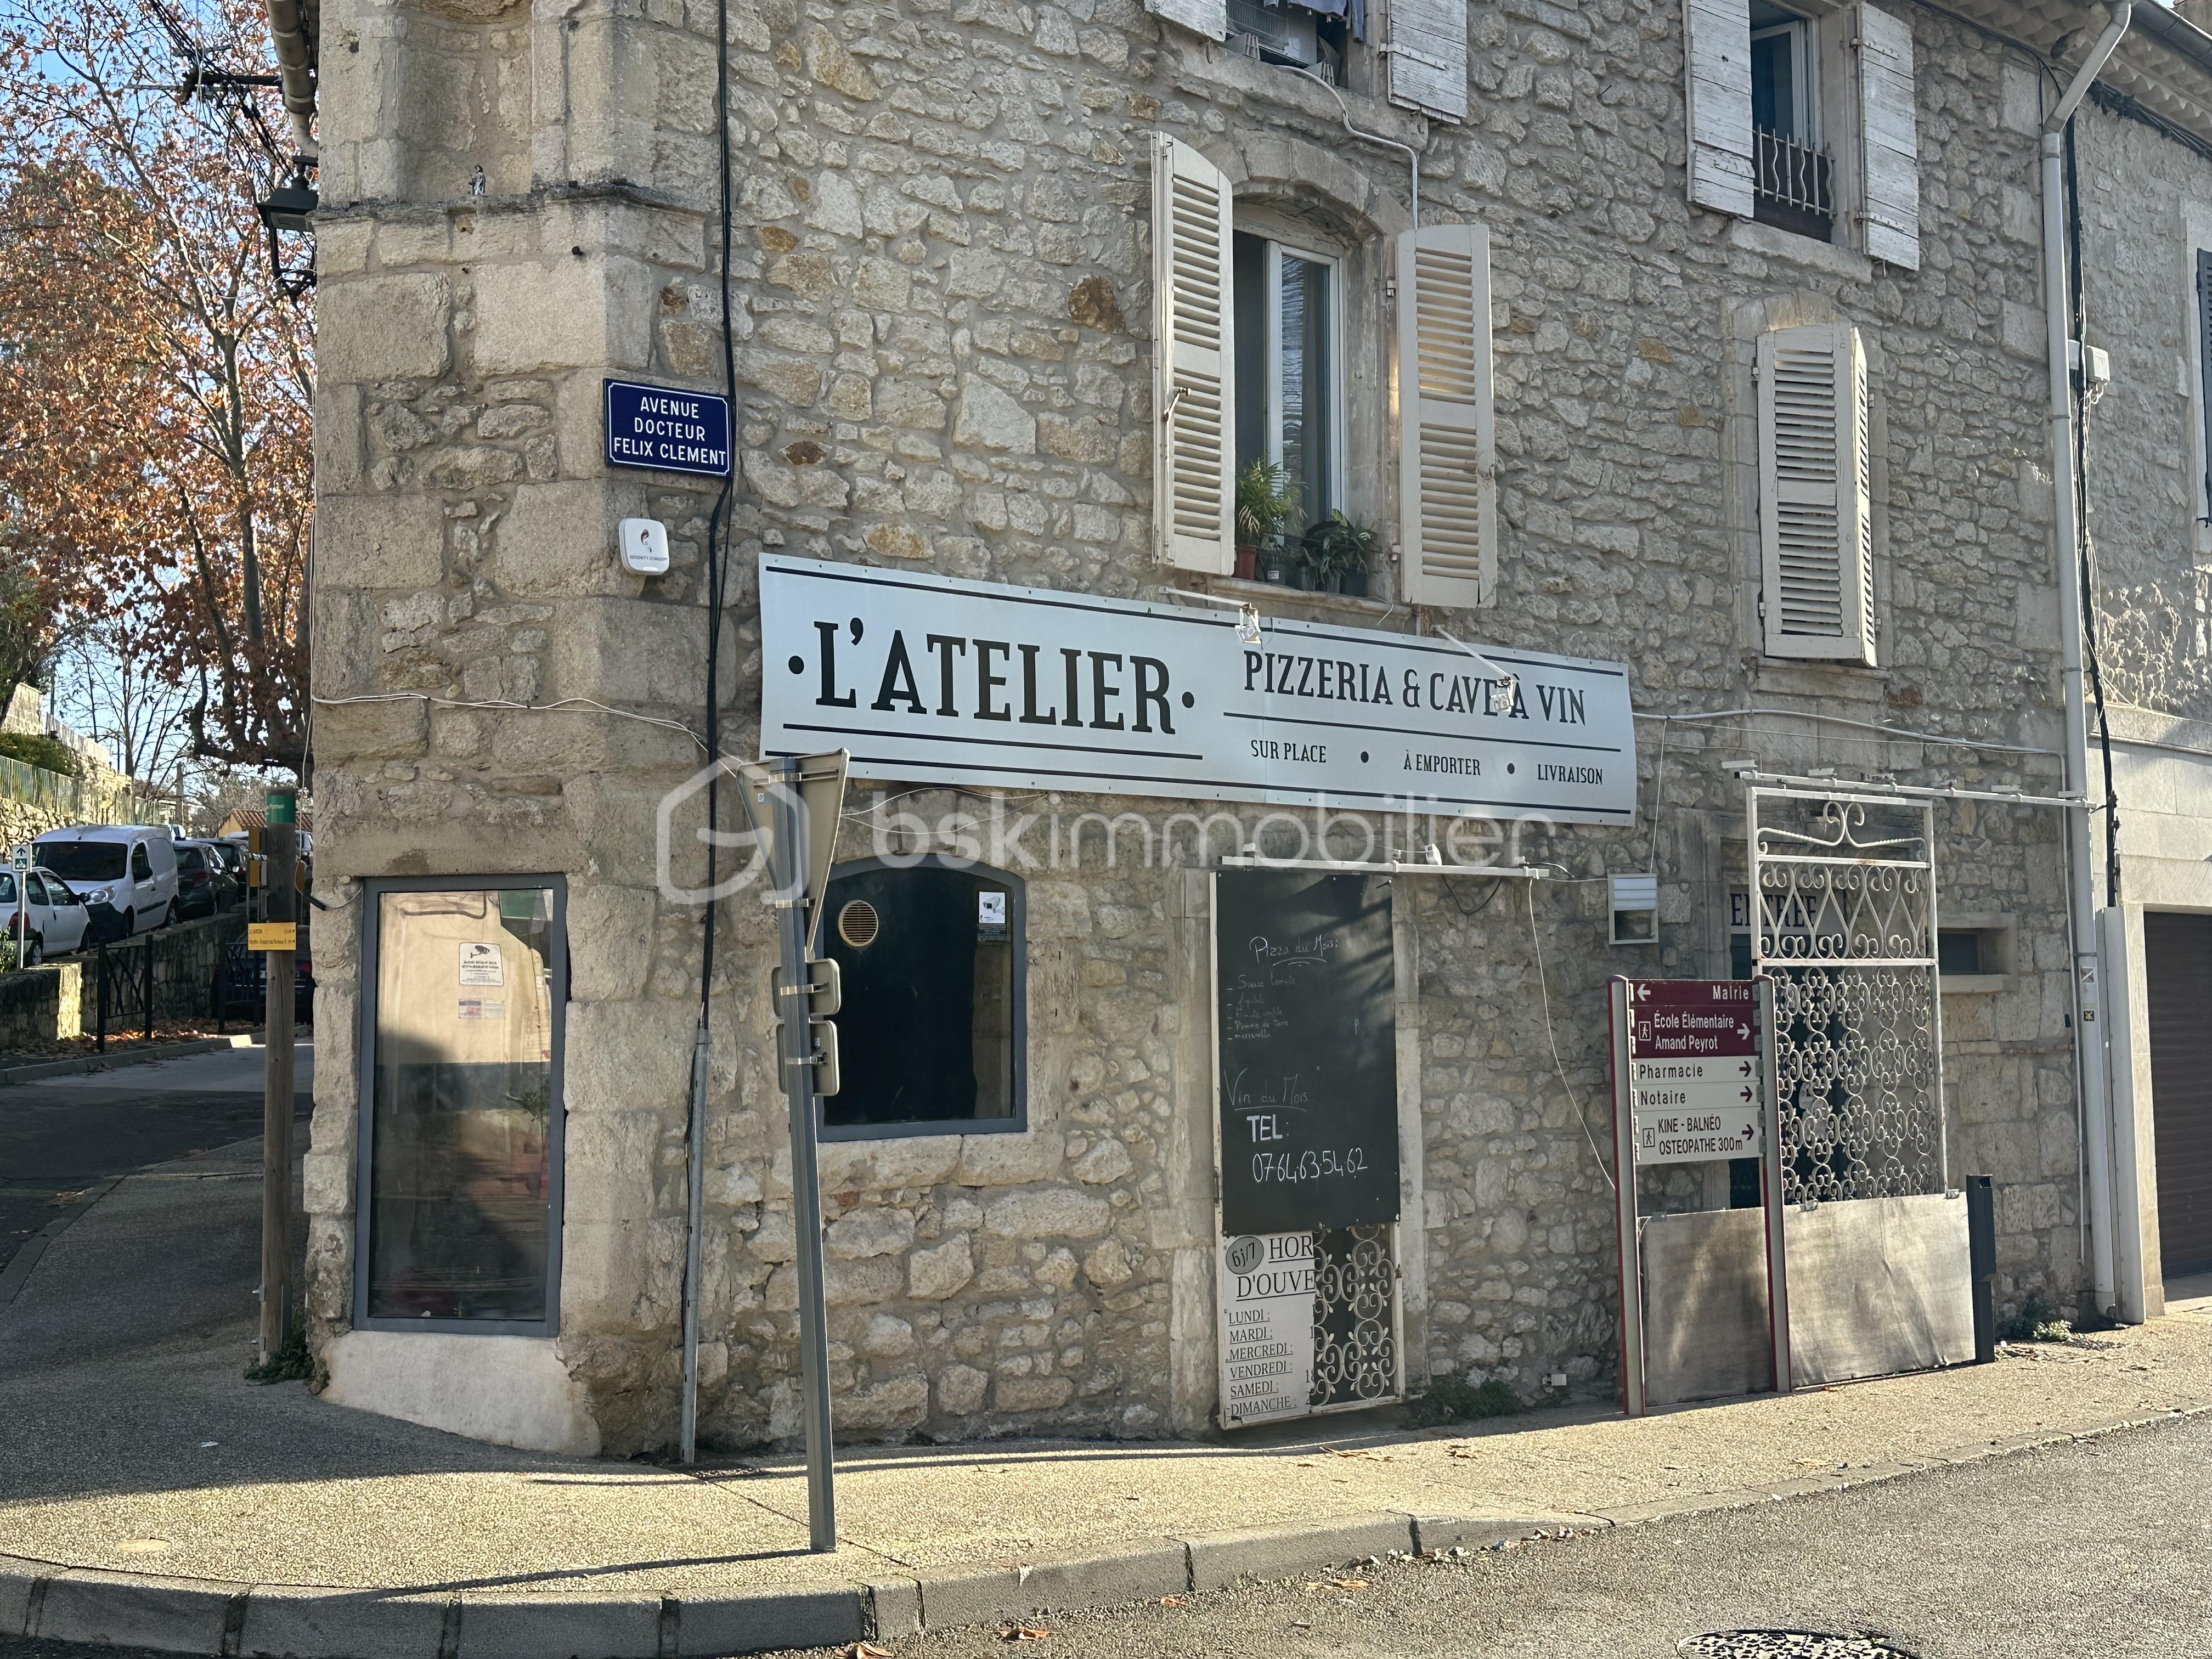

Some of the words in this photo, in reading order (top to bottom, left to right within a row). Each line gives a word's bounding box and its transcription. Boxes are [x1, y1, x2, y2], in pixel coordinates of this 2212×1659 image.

[640, 396, 699, 419] AVENUE
[634, 417, 706, 442] DOCTEUR
[614, 437, 653, 457] FELIX
[660, 443, 726, 466] CLEMENT
[1244, 650, 1393, 706] PIZZERIA
[1403, 668, 1420, 708] &
[1429, 672, 1498, 716] CAVE
[1509, 673, 1530, 720] À
[1536, 684, 1585, 726] VIN
[1251, 740, 1279, 760] SUR
[1284, 742, 1327, 763] PLACE
[1403, 749, 1412, 770] À
[1415, 754, 1481, 776] EMPORTER
[1537, 764, 1603, 785] LIVRAISON
[1249, 936, 1289, 965] Pizza
[1295, 936, 1310, 953] du
[1712, 985, 1749, 1001] Mairie
[1654, 1009, 1680, 1029] École
[1682, 1010, 1734, 1029] Élémentaire
[1655, 1035, 1686, 1050] Amand
[1689, 1035, 1718, 1053] Peyrot
[1640, 1063, 1703, 1079] Pharmacie
[1223, 1067, 1251, 1107] Vin
[1261, 1077, 1276, 1103] du
[1641, 1090, 1686, 1106] Notaire
[1658, 1118, 1679, 1134] KINE
[1687, 1113, 1721, 1132] BALNÉO
[1659, 1137, 1716, 1155] OSTEOPATHE
[1719, 1136, 1743, 1152] 300m
[1232, 1242, 1255, 1267] 6j/7
[1237, 1269, 1316, 1298] D'OUVE
